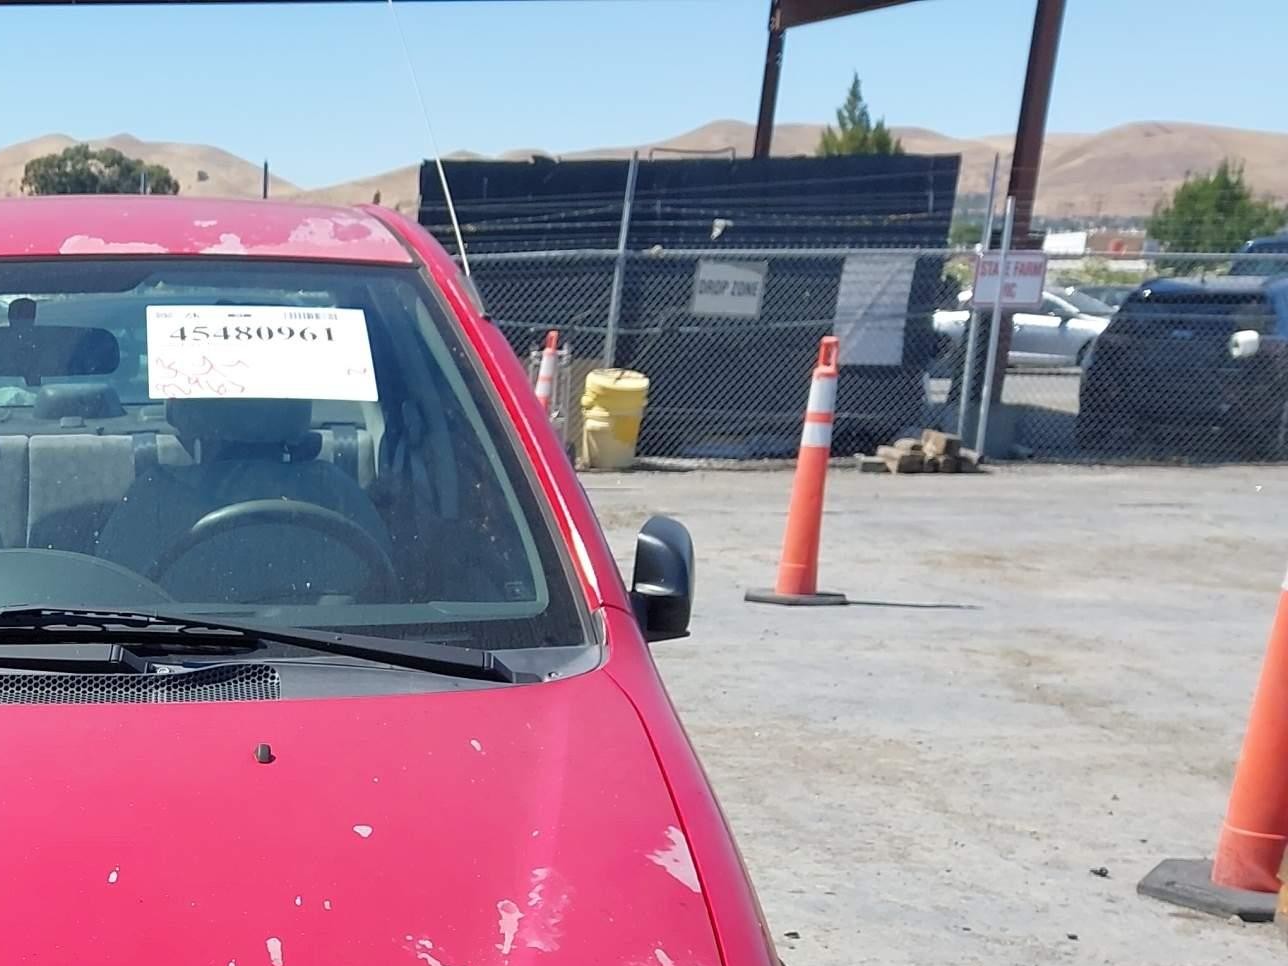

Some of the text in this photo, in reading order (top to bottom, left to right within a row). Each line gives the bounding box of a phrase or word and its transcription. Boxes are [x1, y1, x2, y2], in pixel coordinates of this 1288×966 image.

[698, 279, 759, 296] DROP ZONE
[169, 325, 337, 342] 45480961
